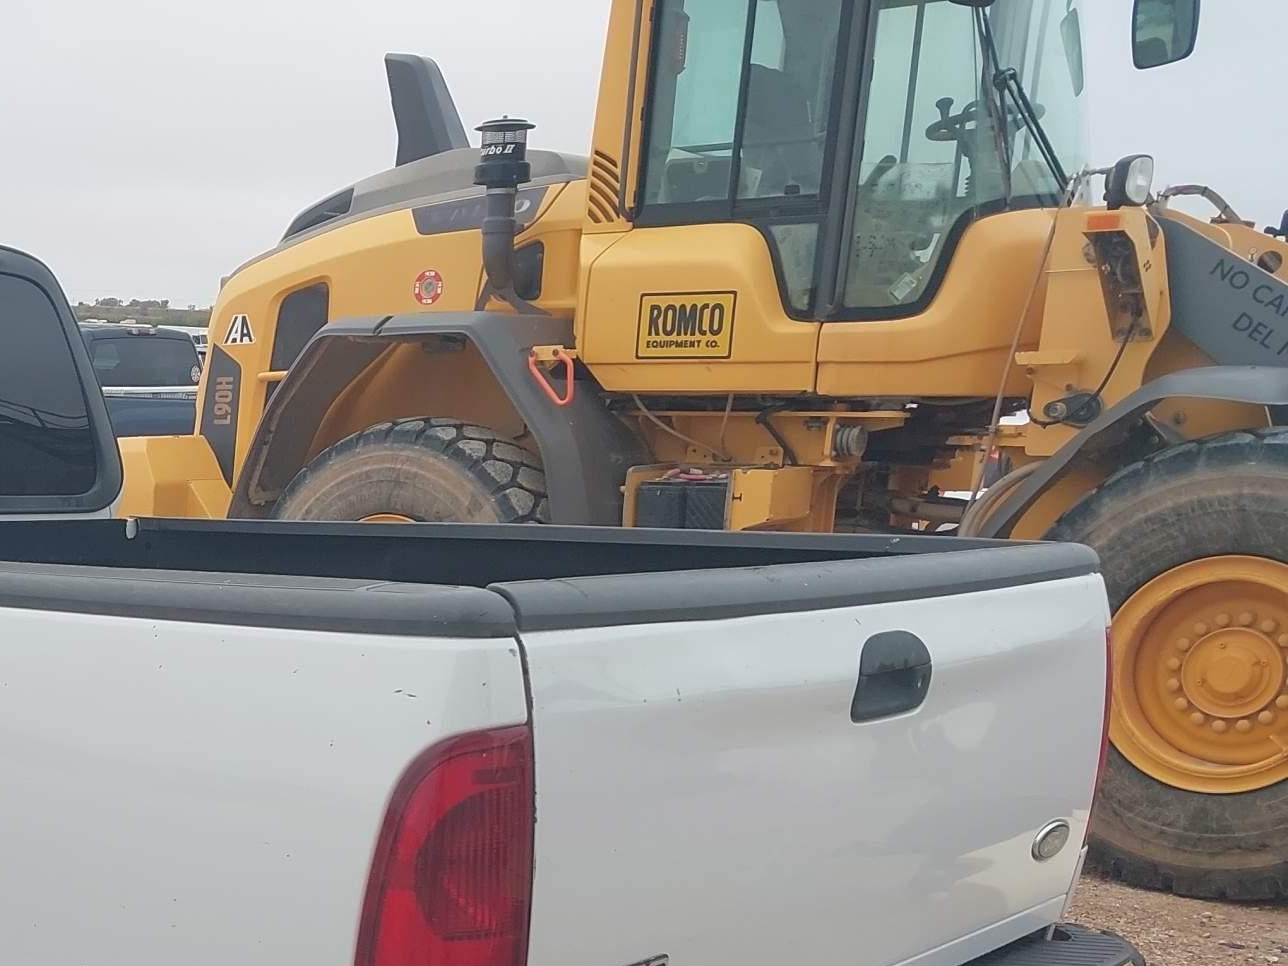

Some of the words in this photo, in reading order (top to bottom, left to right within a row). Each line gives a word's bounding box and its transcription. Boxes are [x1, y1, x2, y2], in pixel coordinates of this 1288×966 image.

[1209, 258, 1250, 290] NO
[648, 303, 725, 336] ROMCO
[1232, 312, 1275, 349] DEL
[646, 340, 702, 349] EQUIPMENT
[705, 340, 721, 348] CO.
[213, 376, 234, 425] L90H
